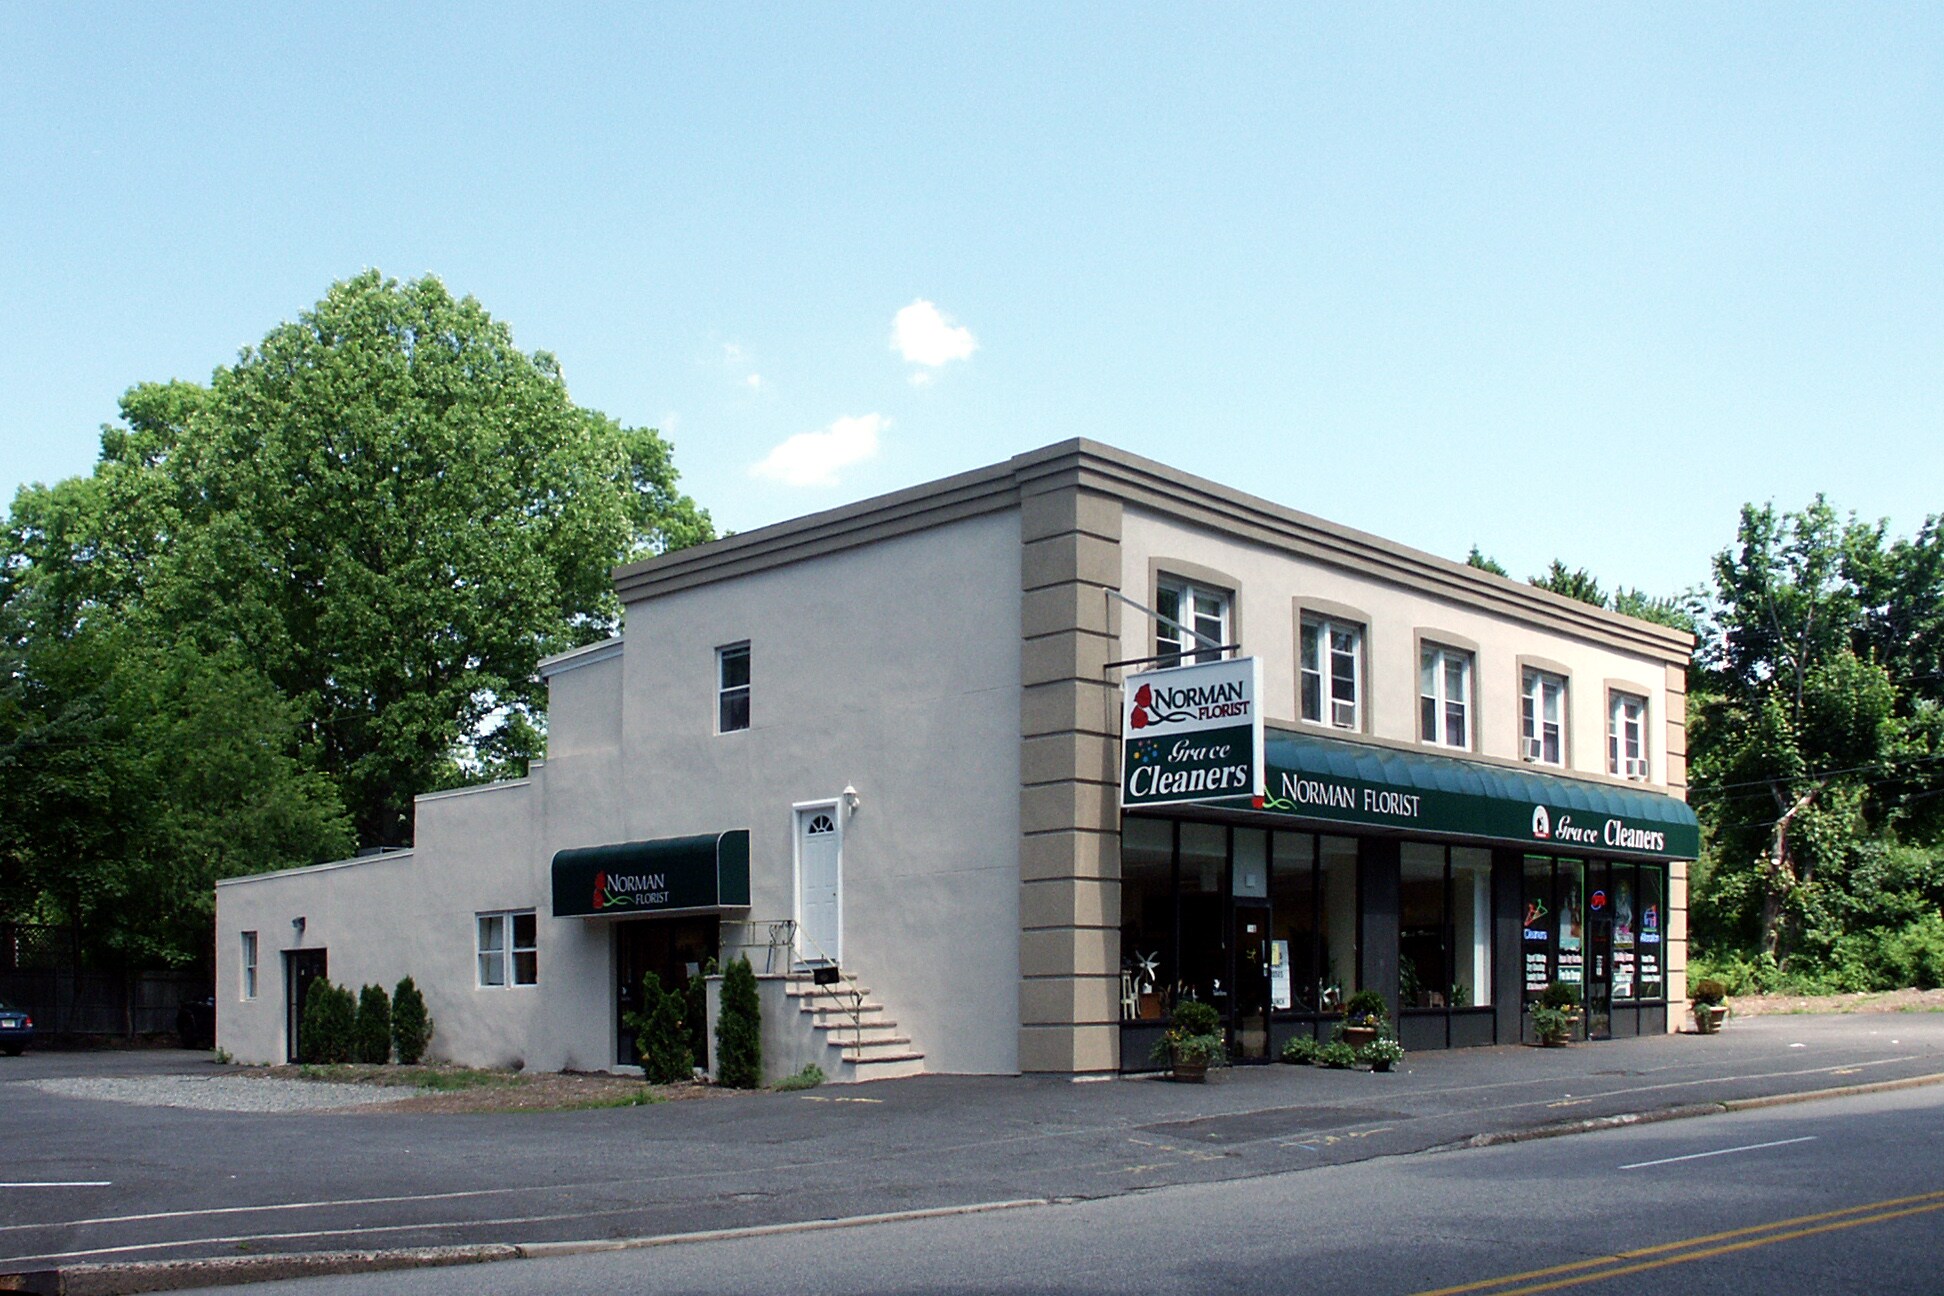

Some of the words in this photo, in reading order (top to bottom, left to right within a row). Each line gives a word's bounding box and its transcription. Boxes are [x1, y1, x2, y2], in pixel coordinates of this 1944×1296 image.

[1154, 681, 1243, 710] NORMAN
[1198, 701, 1250, 720] FLORIST
[1168, 739, 1231, 763] Grace
[1129, 763, 1248, 797] Cleaners
[1281, 772, 1356, 809] NORMAN
[1364, 789, 1420, 817] FLORIST
[1555, 815, 1598, 843] Grace
[1604, 819, 1665, 851] Cleaners
[606, 873, 665, 892] NORMAN
[635, 892, 669, 905] FLORIST
